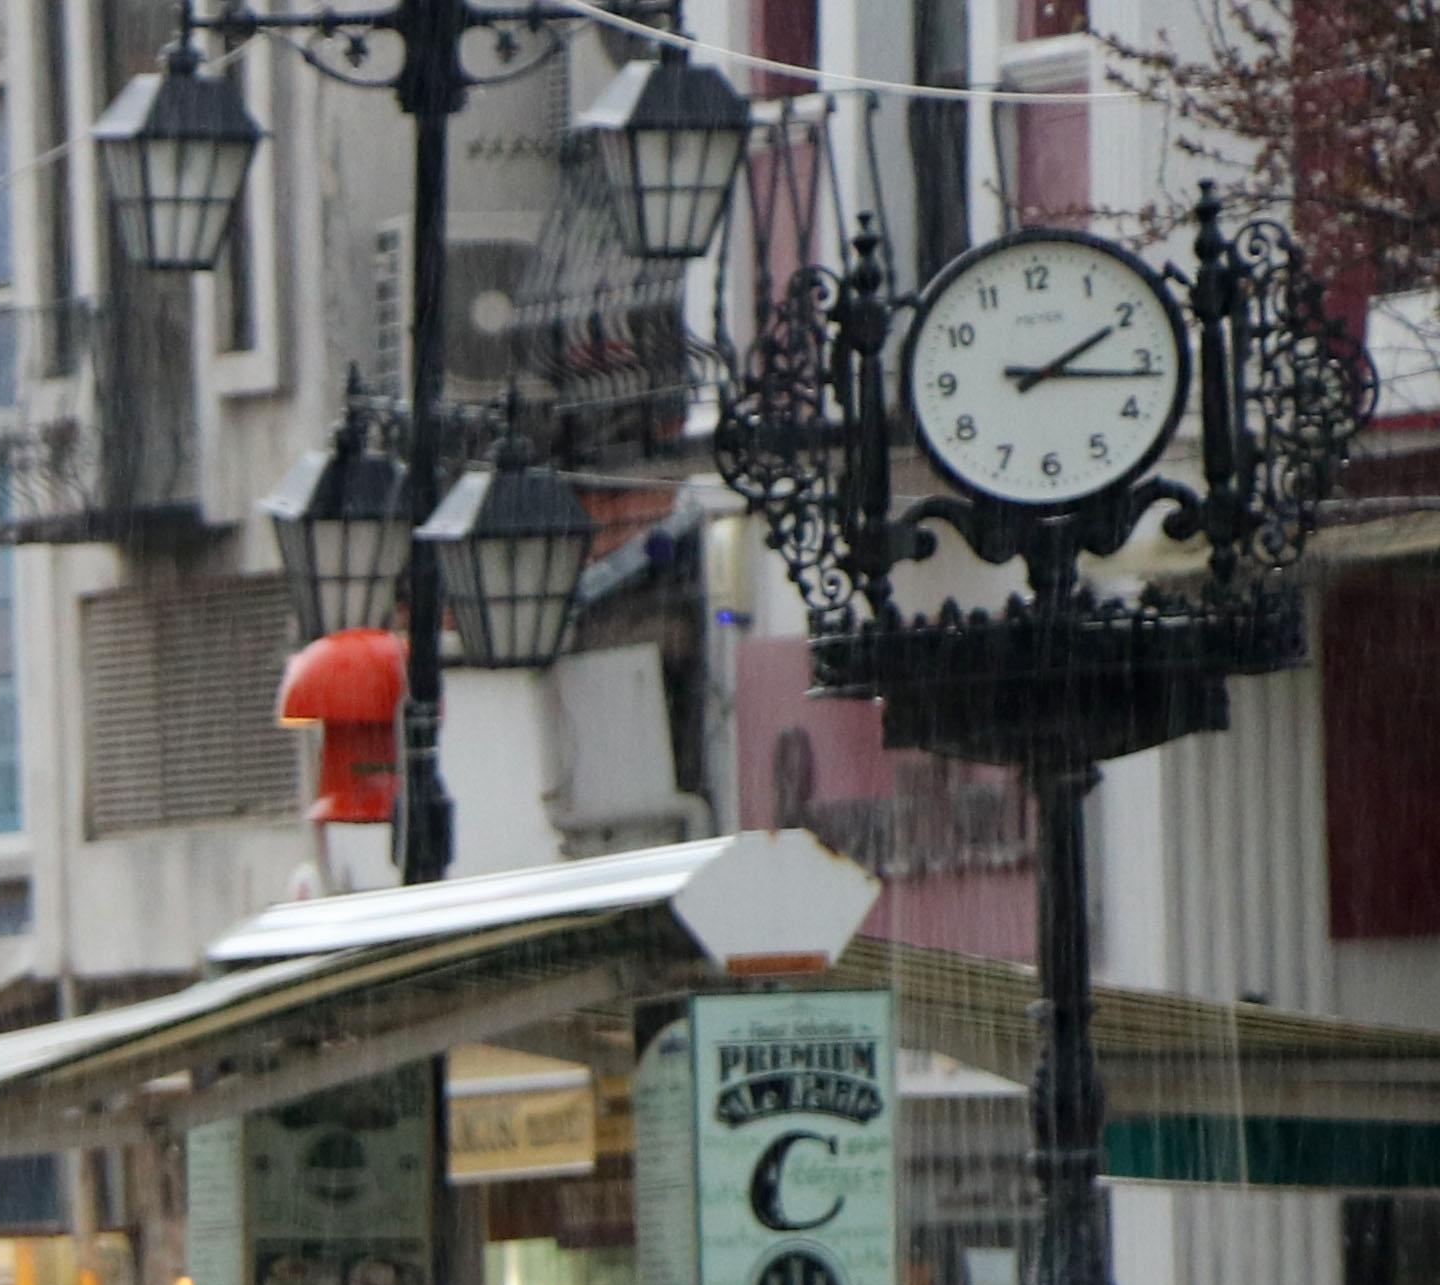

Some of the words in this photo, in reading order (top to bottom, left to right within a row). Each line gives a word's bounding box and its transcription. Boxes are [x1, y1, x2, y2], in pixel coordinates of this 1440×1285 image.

[1024, 265, 1050, 291] 12
[1083, 275, 1093, 298] 1
[978, 284, 998, 310] 11
[1116, 302, 1135, 328] 2
[948, 322, 976, 349] 10
[1134, 348, 1153, 372] 3
[937, 372, 958, 397] 9
[1119, 395, 1140, 419] 4
[955, 413, 977, 441] 8
[997, 444, 1014, 470] 7
[1089, 433, 1108, 459] 5
[1041, 452, 1062, 476] 6
[717, 1040, 877, 1082] PREMIUM
